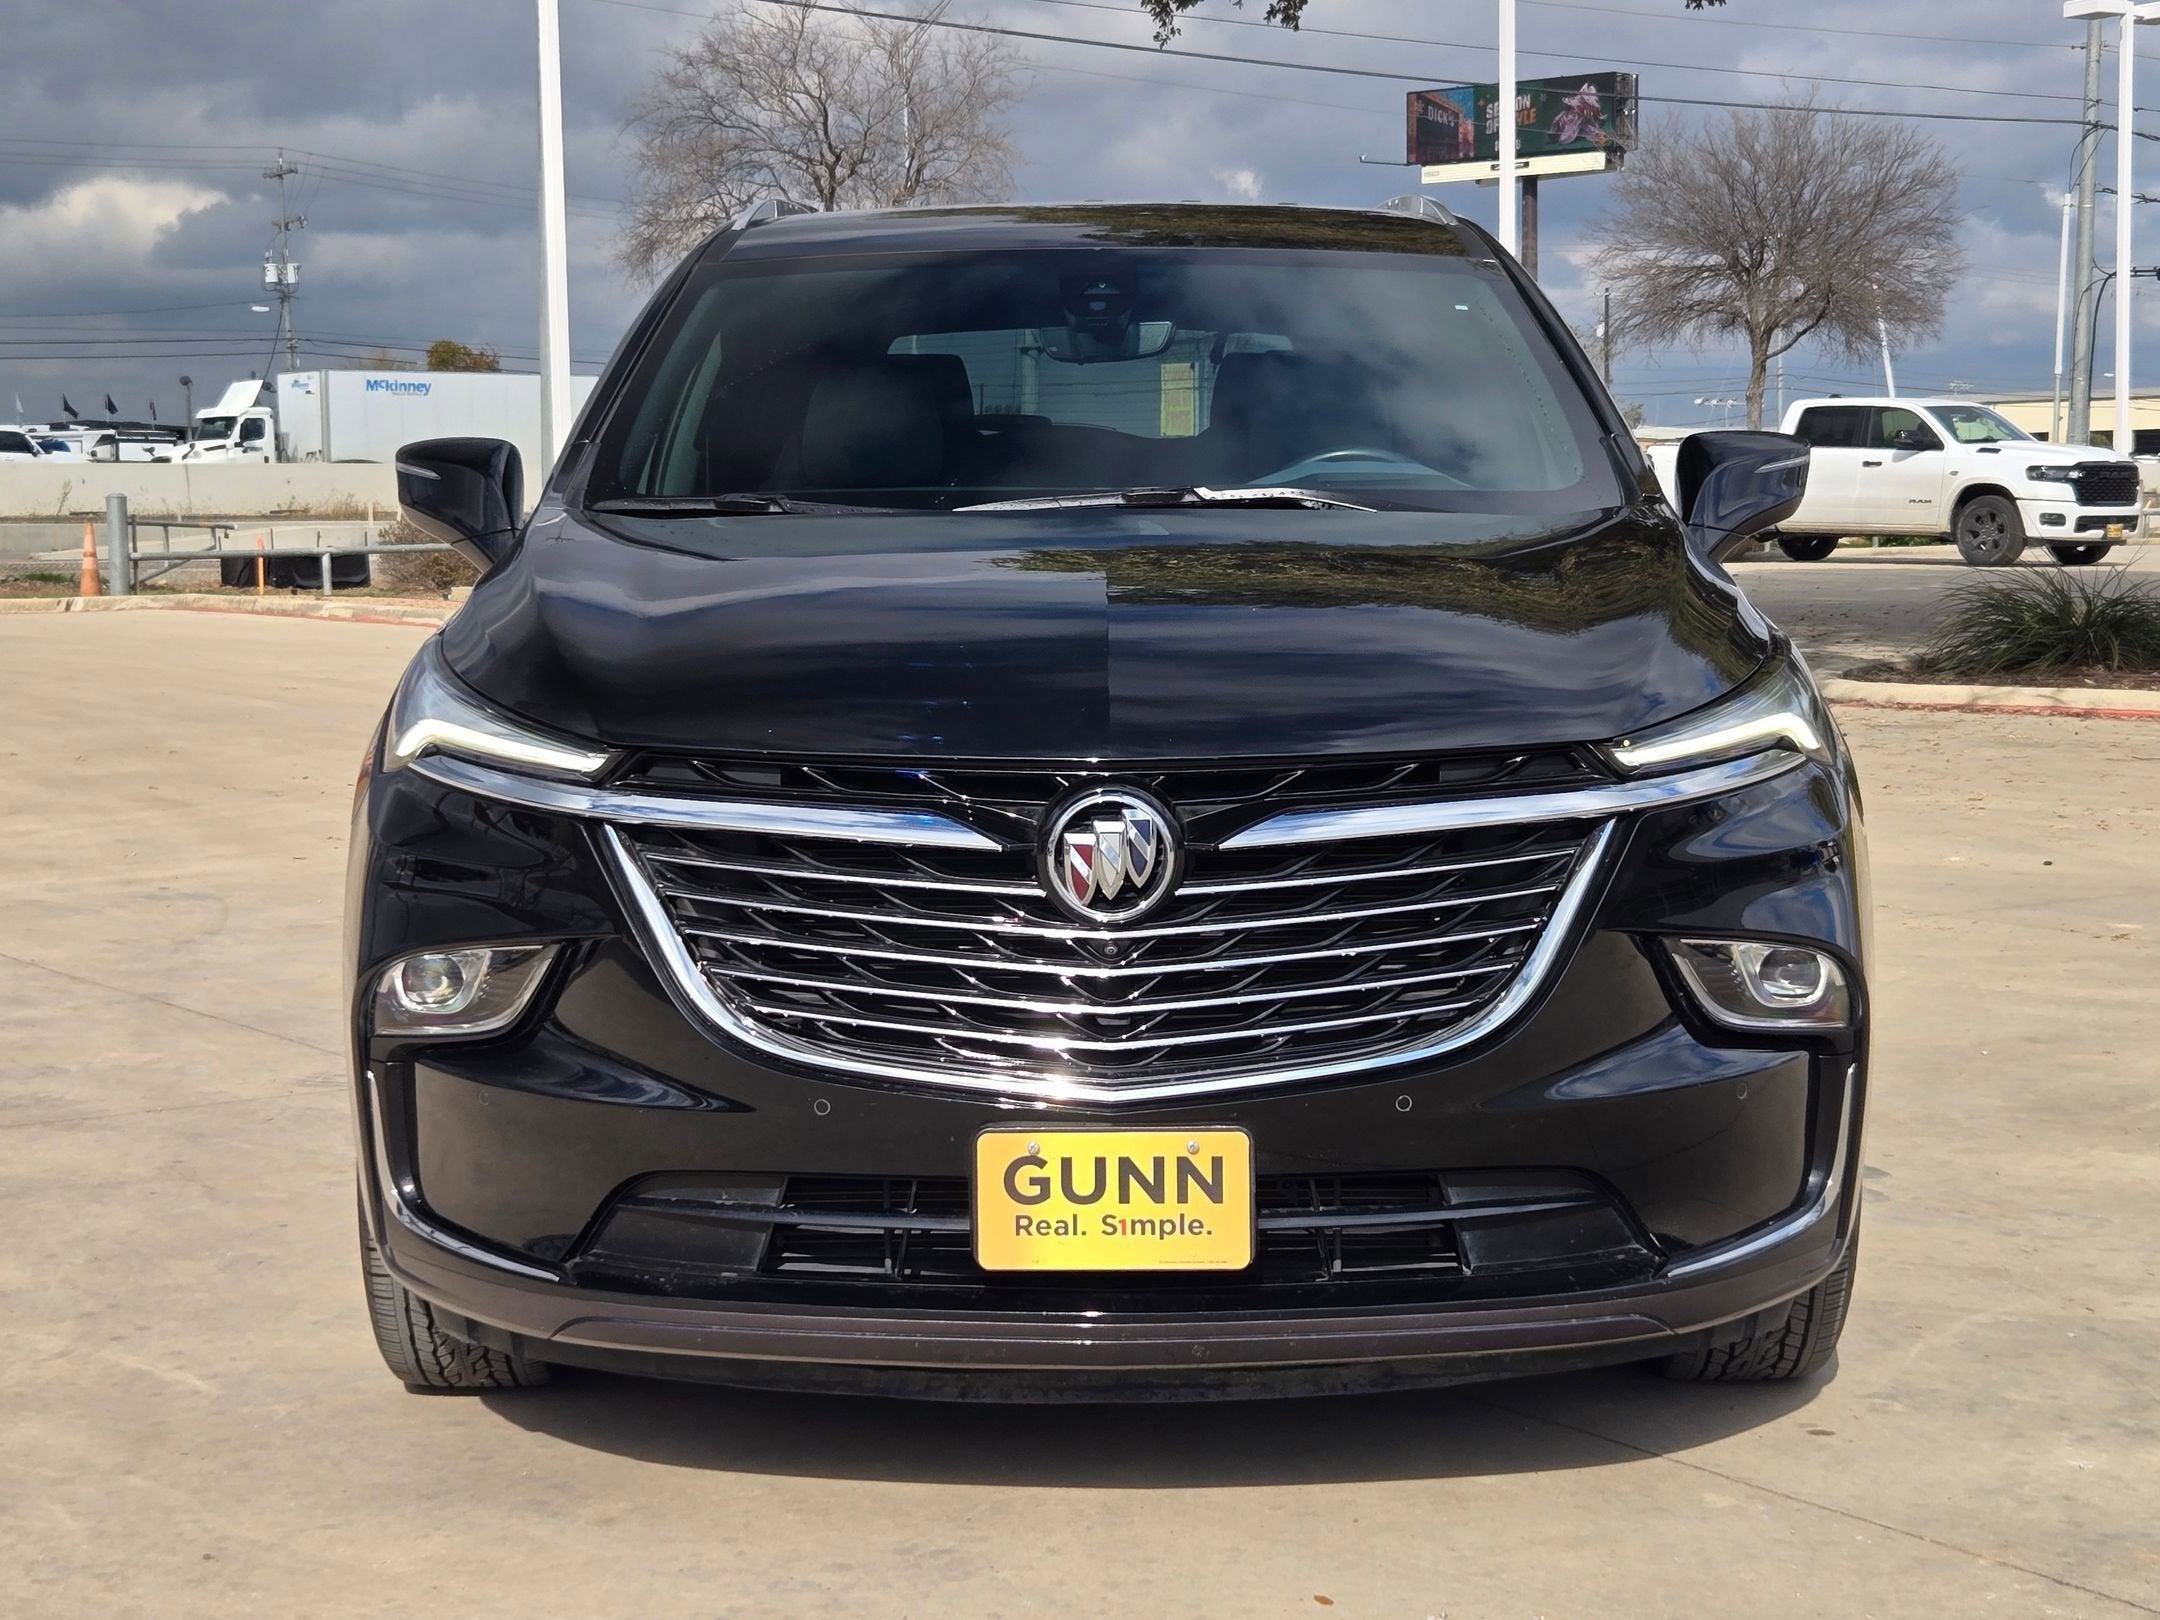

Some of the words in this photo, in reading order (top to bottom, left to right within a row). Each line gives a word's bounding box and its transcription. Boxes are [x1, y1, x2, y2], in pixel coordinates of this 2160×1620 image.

[1486, 94, 1531, 119] SEON
[1003, 1155, 1224, 1206] GUNN
[1015, 1214, 1087, 1236] Real.
